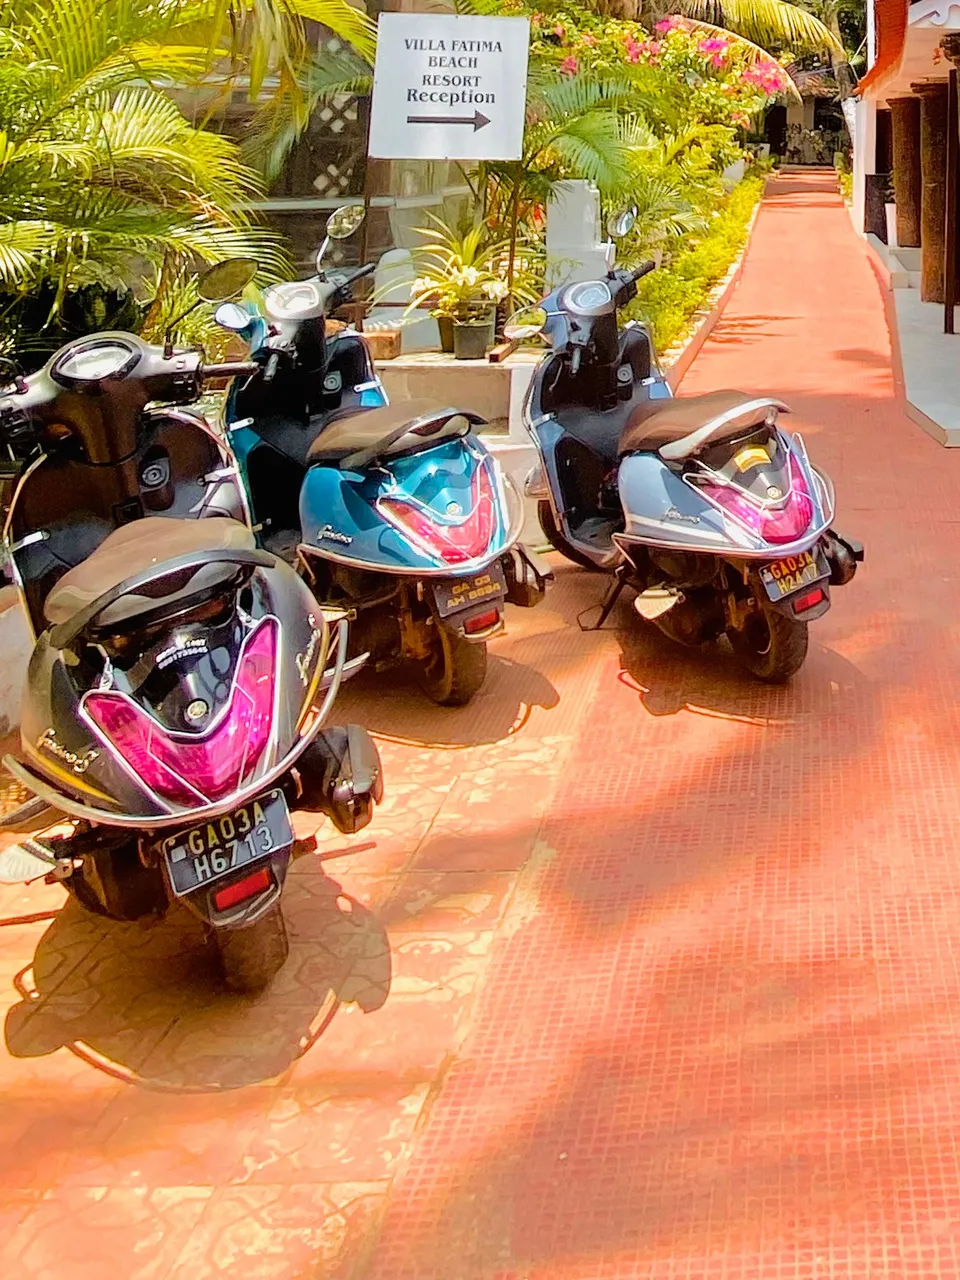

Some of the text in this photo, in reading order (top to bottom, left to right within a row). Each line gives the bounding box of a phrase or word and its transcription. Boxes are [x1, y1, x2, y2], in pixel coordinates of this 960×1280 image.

[404, 38, 503, 52] VILLA FATIMA
[428, 56, 478, 69] BEACH
[422, 74, 482, 87] RESORT
[406, 88, 496, 106] Reception
[188, 801, 267, 855] GA03A
[193, 826, 274, 881] H6713
